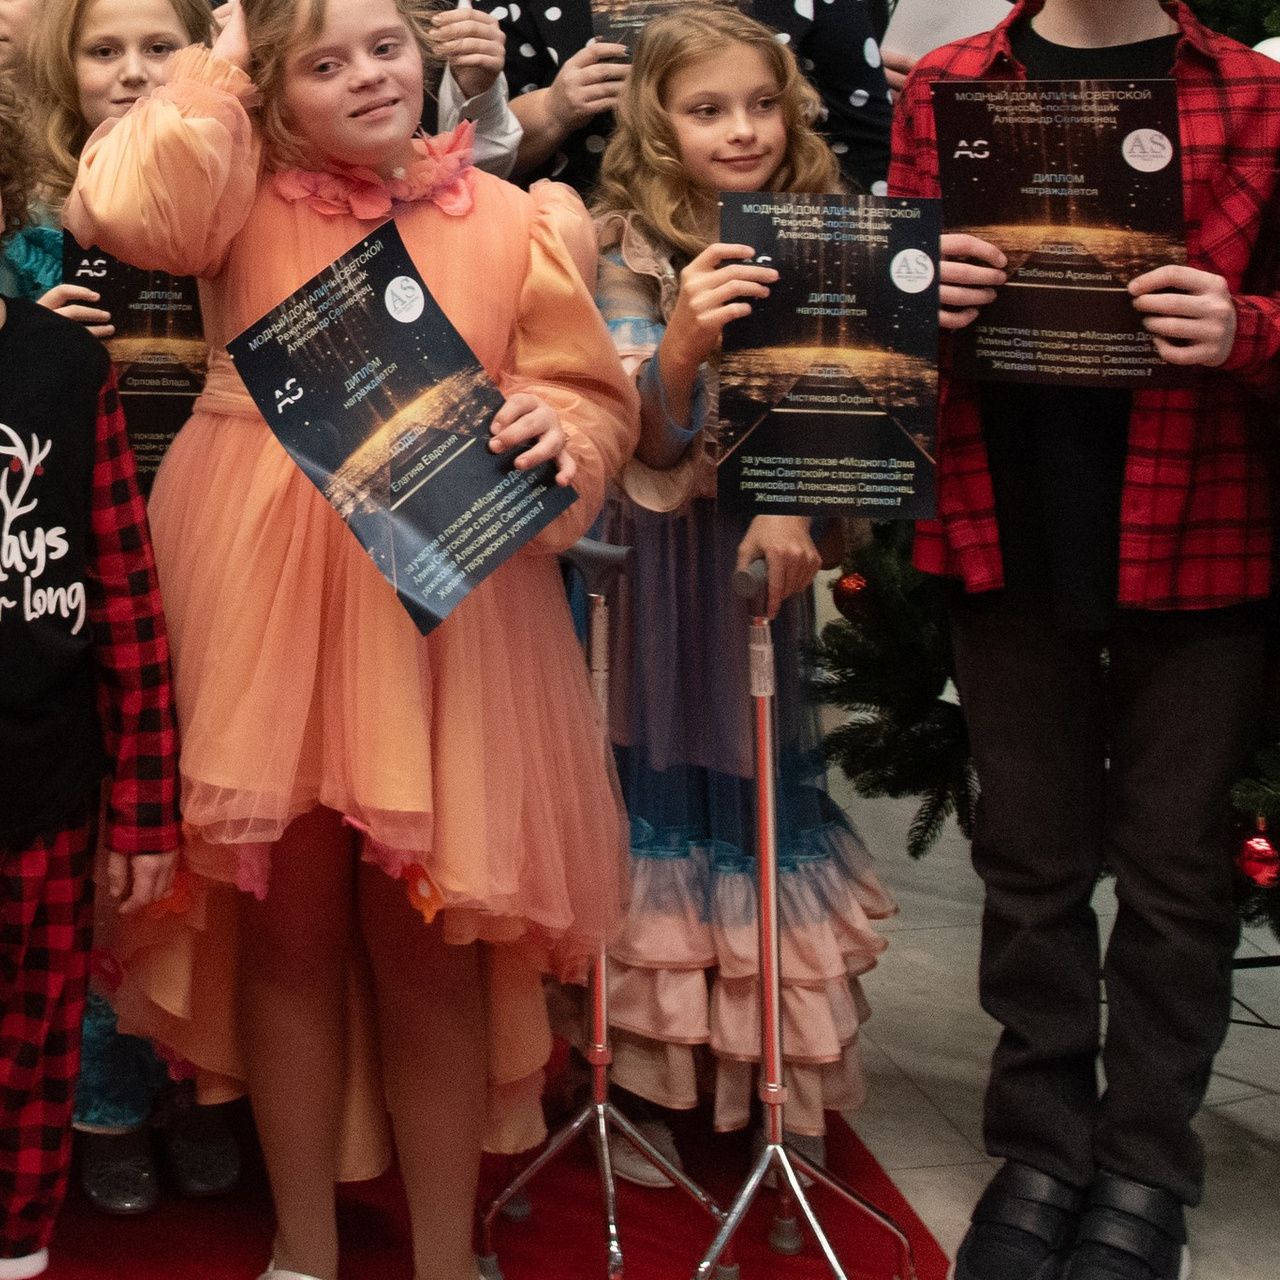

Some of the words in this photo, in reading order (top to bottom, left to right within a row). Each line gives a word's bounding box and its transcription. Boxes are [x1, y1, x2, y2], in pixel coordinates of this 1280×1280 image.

[955, 90, 1009, 102] МОДНЫЙ
[1010, 92, 1038, 102] ДОМ
[1086, 89, 1151, 100] СВЕТСКОЙ
[953, 140, 990, 159] AS
[1128, 133, 1167, 154] AS
[1032, 173, 1084, 184] ДИПЛОМ
[1021, 187, 1099, 196] награждается
[742, 203, 794, 215] МОДНЫЙ
[794, 206, 820, 216] ДОМ
[863, 208, 921, 218] СВЕТСКОЙ
[777, 229, 832, 242] Александр
[75, 259, 107, 277] AS
[895, 253, 929, 274] AS
[1018, 268, 1064, 279] Бабенко
[1066, 270, 1112, 281] Арсений
[139, 291, 183, 300] ДИПЛОМ
[248, 312, 291, 351] МОДНЫЙ
[289, 299, 310, 322] ДОМ
[309, 278, 338, 304] АЛИНЫ
[338, 240, 384, 279] СВЕТСКОЙ
[392, 277, 416, 312] AS
[808, 293, 856, 304] ДИПЛОМ
[287, 317, 330, 354] Александр
[328, 284, 373, 320] Селивонец
[797, 307, 867, 317] награждается
[344, 356, 382, 393] ДИПЛОМ
[275, 378, 303, 414] AS
[343, 362, 398, 409] награждается
[840, 394, 874, 405] София
[391, 462, 424, 492] Елагина
[422, 434, 458, 466] Евдокия
[888, 459, 915, 468] Дома
[479, 479, 530, 525] постановкой
[438, 535, 445, 543] в
[444, 511, 472, 538] показе
[455, 521, 503, 563] Александра
[465, 534, 510, 573] творческих
[24, 576, 86, 635] Long
